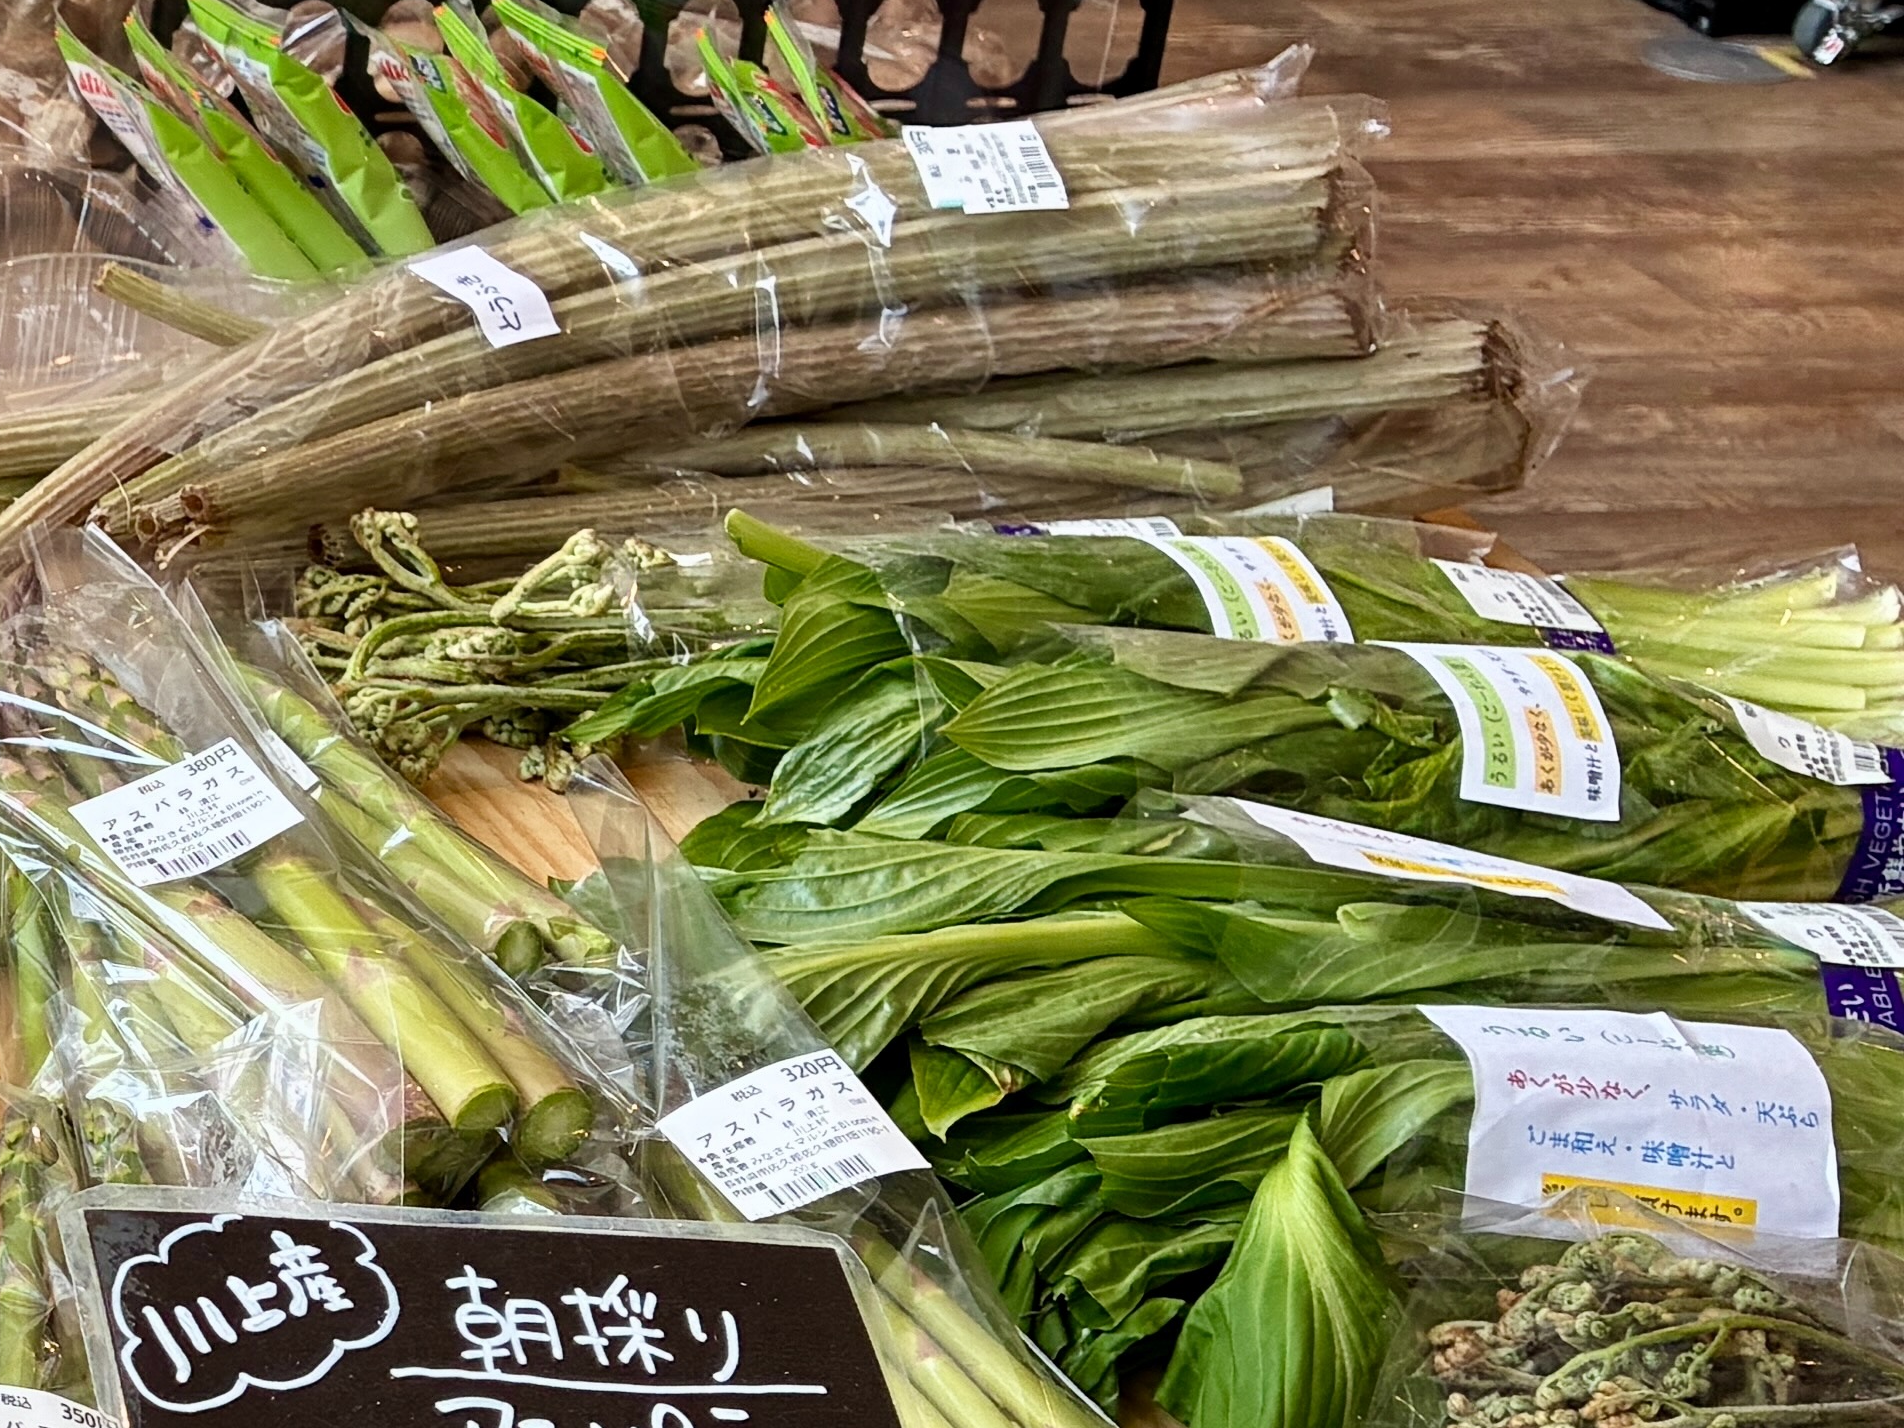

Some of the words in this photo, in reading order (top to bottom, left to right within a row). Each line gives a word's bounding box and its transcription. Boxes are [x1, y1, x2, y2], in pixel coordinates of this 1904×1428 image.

[183, 744, 238, 777] 380円
[1482, 1025, 1586, 1044] うるい
[780, 1055, 842, 1083] 320円
[1506, 1069, 1652, 1102] あくが少なく、
[1667, 1092, 1821, 1129] サラダ・天ぷら
[143, 1228, 355, 1384] 川上産
[444, 1262, 740, 1382] 朝採り
[1, 1393, 32, 1410] 税込
